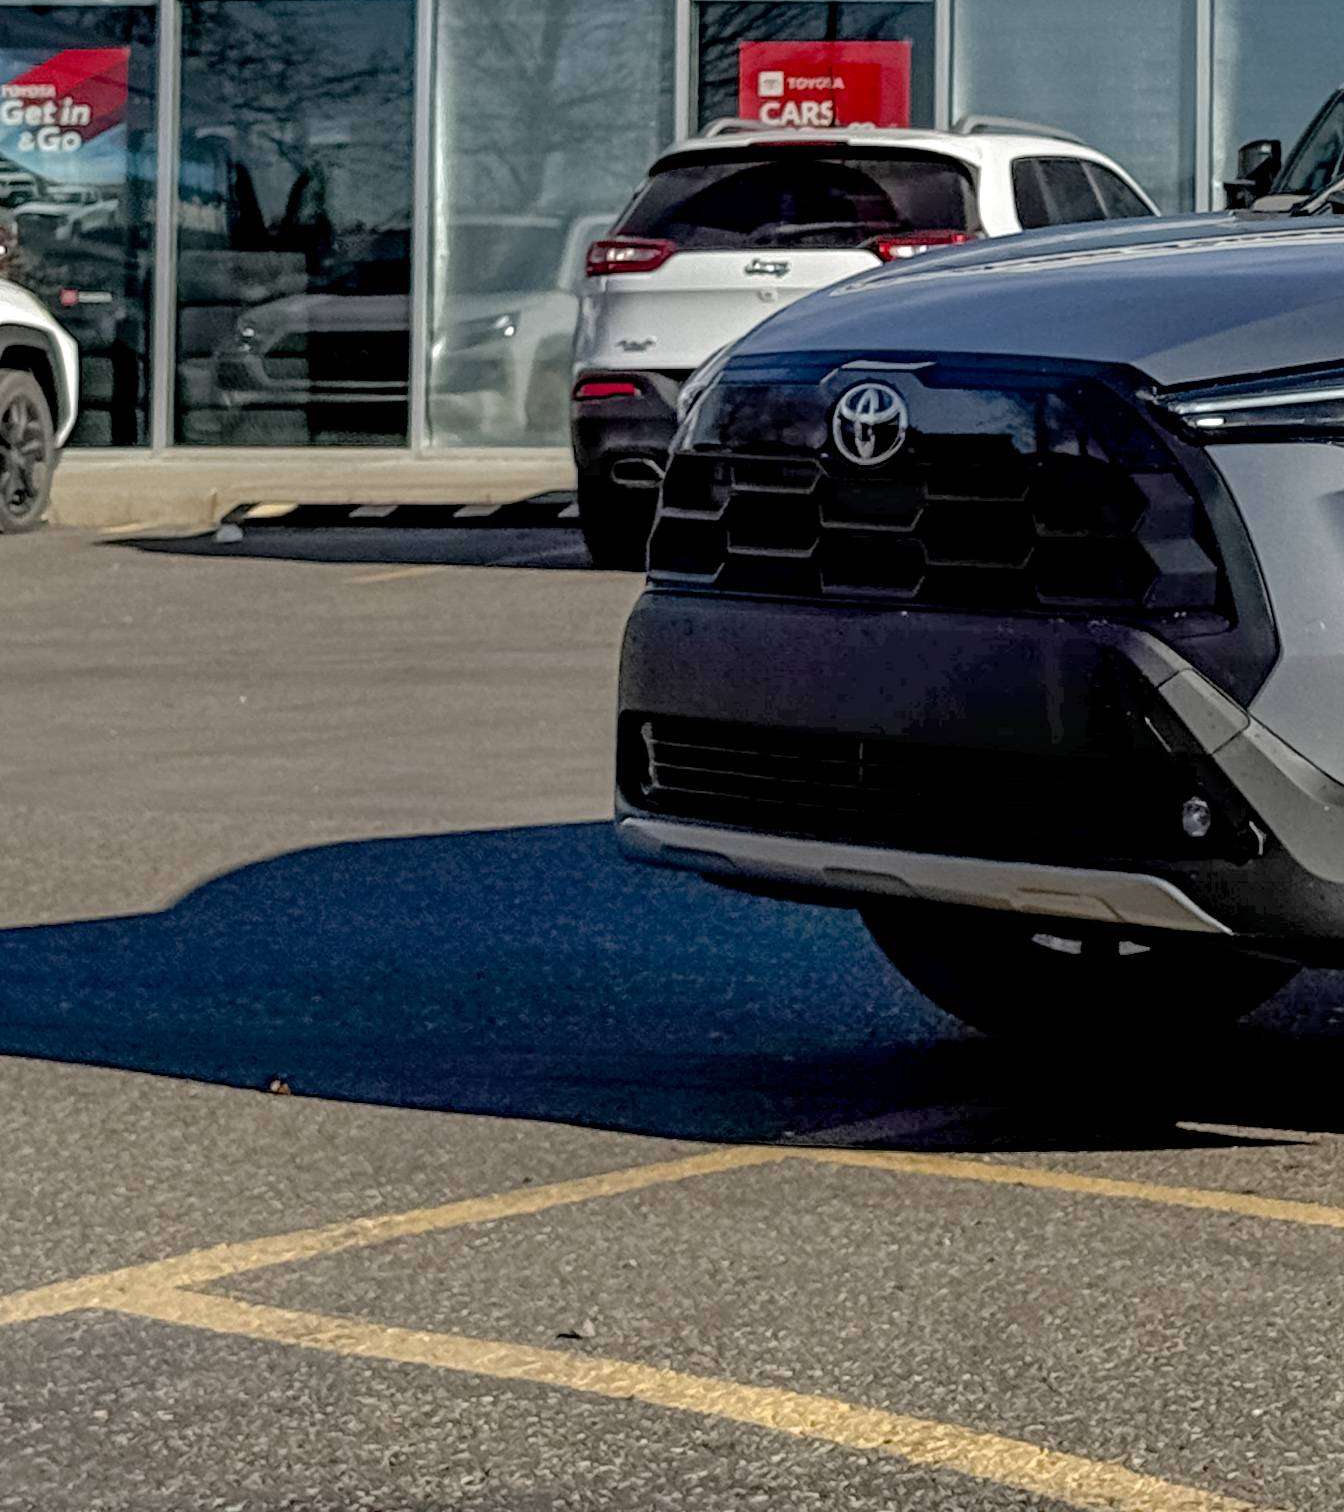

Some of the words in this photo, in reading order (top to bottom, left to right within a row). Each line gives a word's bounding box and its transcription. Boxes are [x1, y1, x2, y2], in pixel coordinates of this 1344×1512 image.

[1, 98, 58, 126] Get
[59, 95, 92, 126] in
[760, 99, 834, 127] CARS
